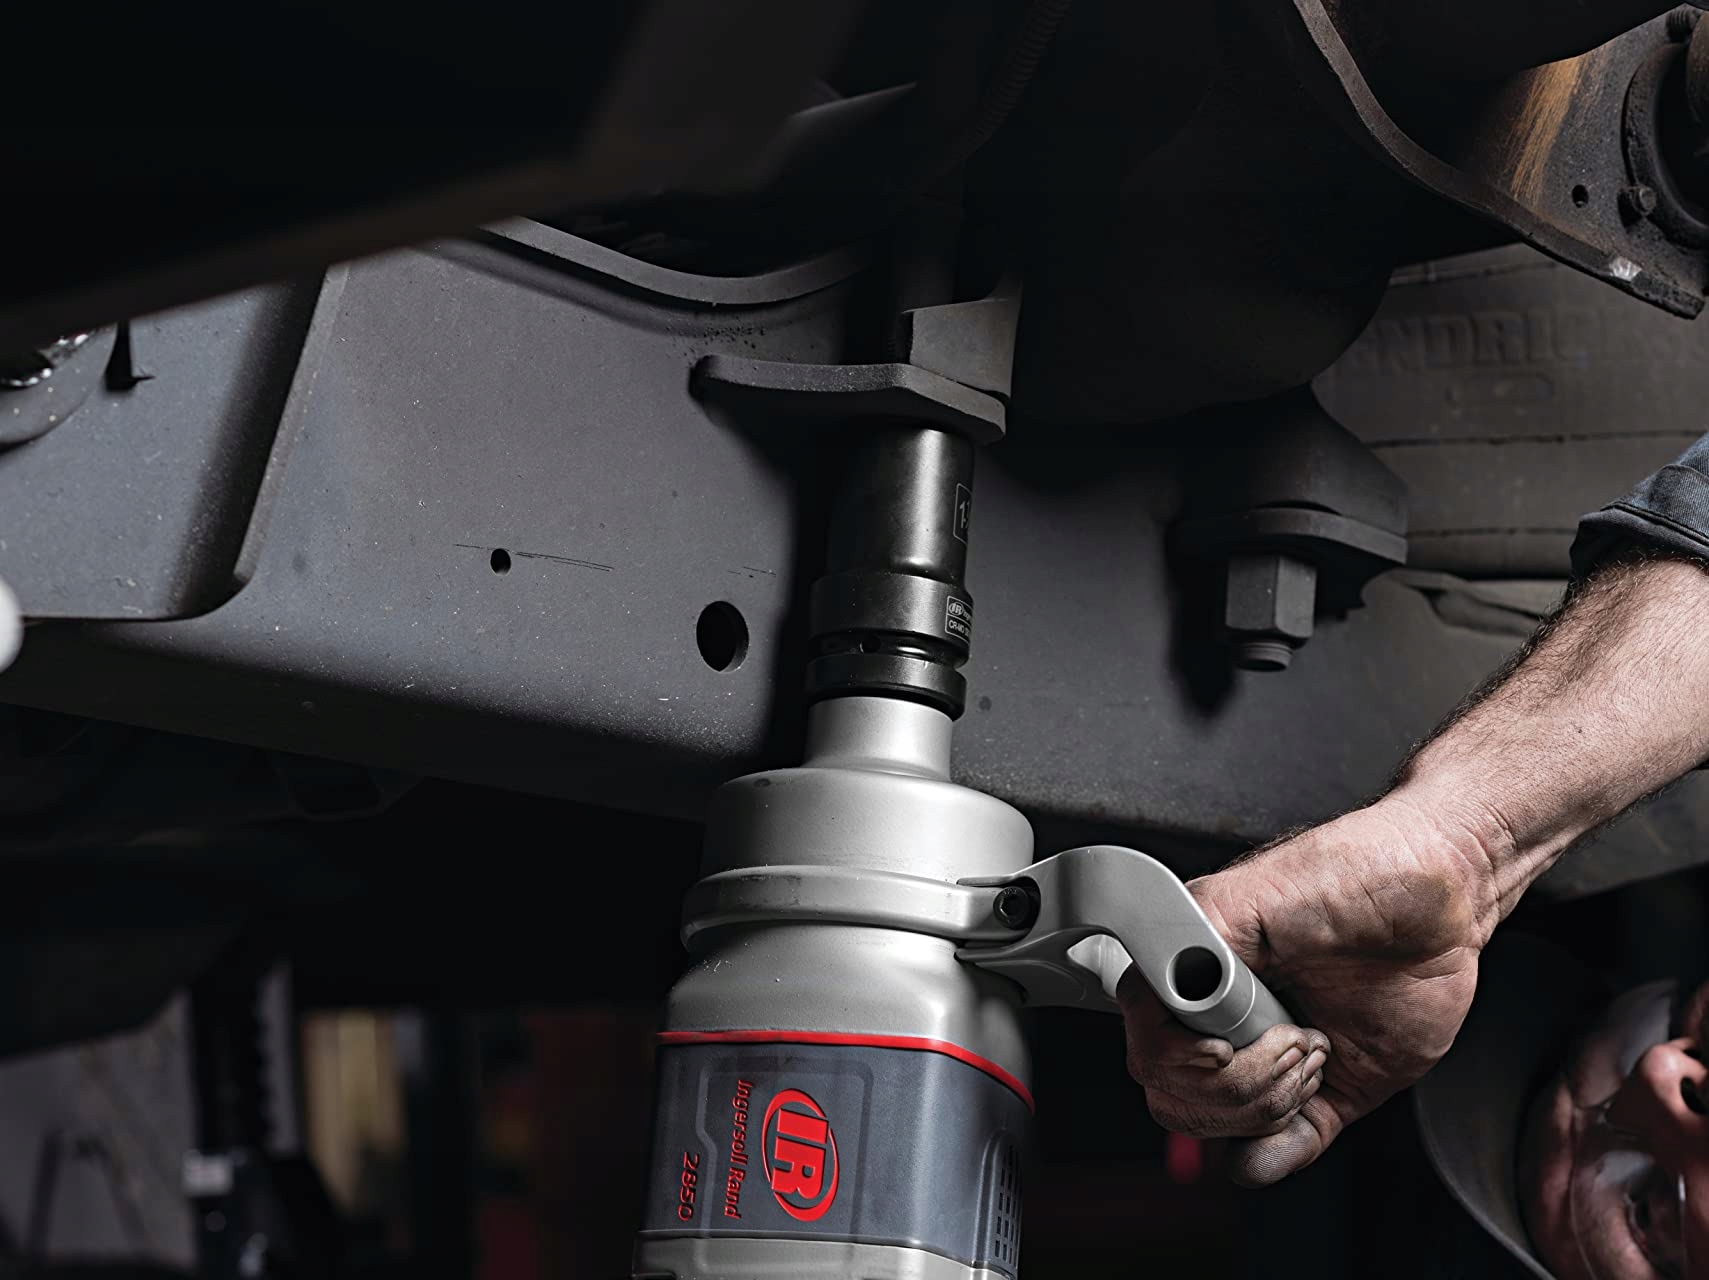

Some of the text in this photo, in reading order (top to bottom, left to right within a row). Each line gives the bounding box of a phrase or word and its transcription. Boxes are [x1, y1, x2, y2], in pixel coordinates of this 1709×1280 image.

[949, 602, 963, 615] IR
[677, 1151, 700, 1221] 2850
[724, 1079, 753, 1219] Ingersoll Rand
[769, 1105, 830, 1201] IR
